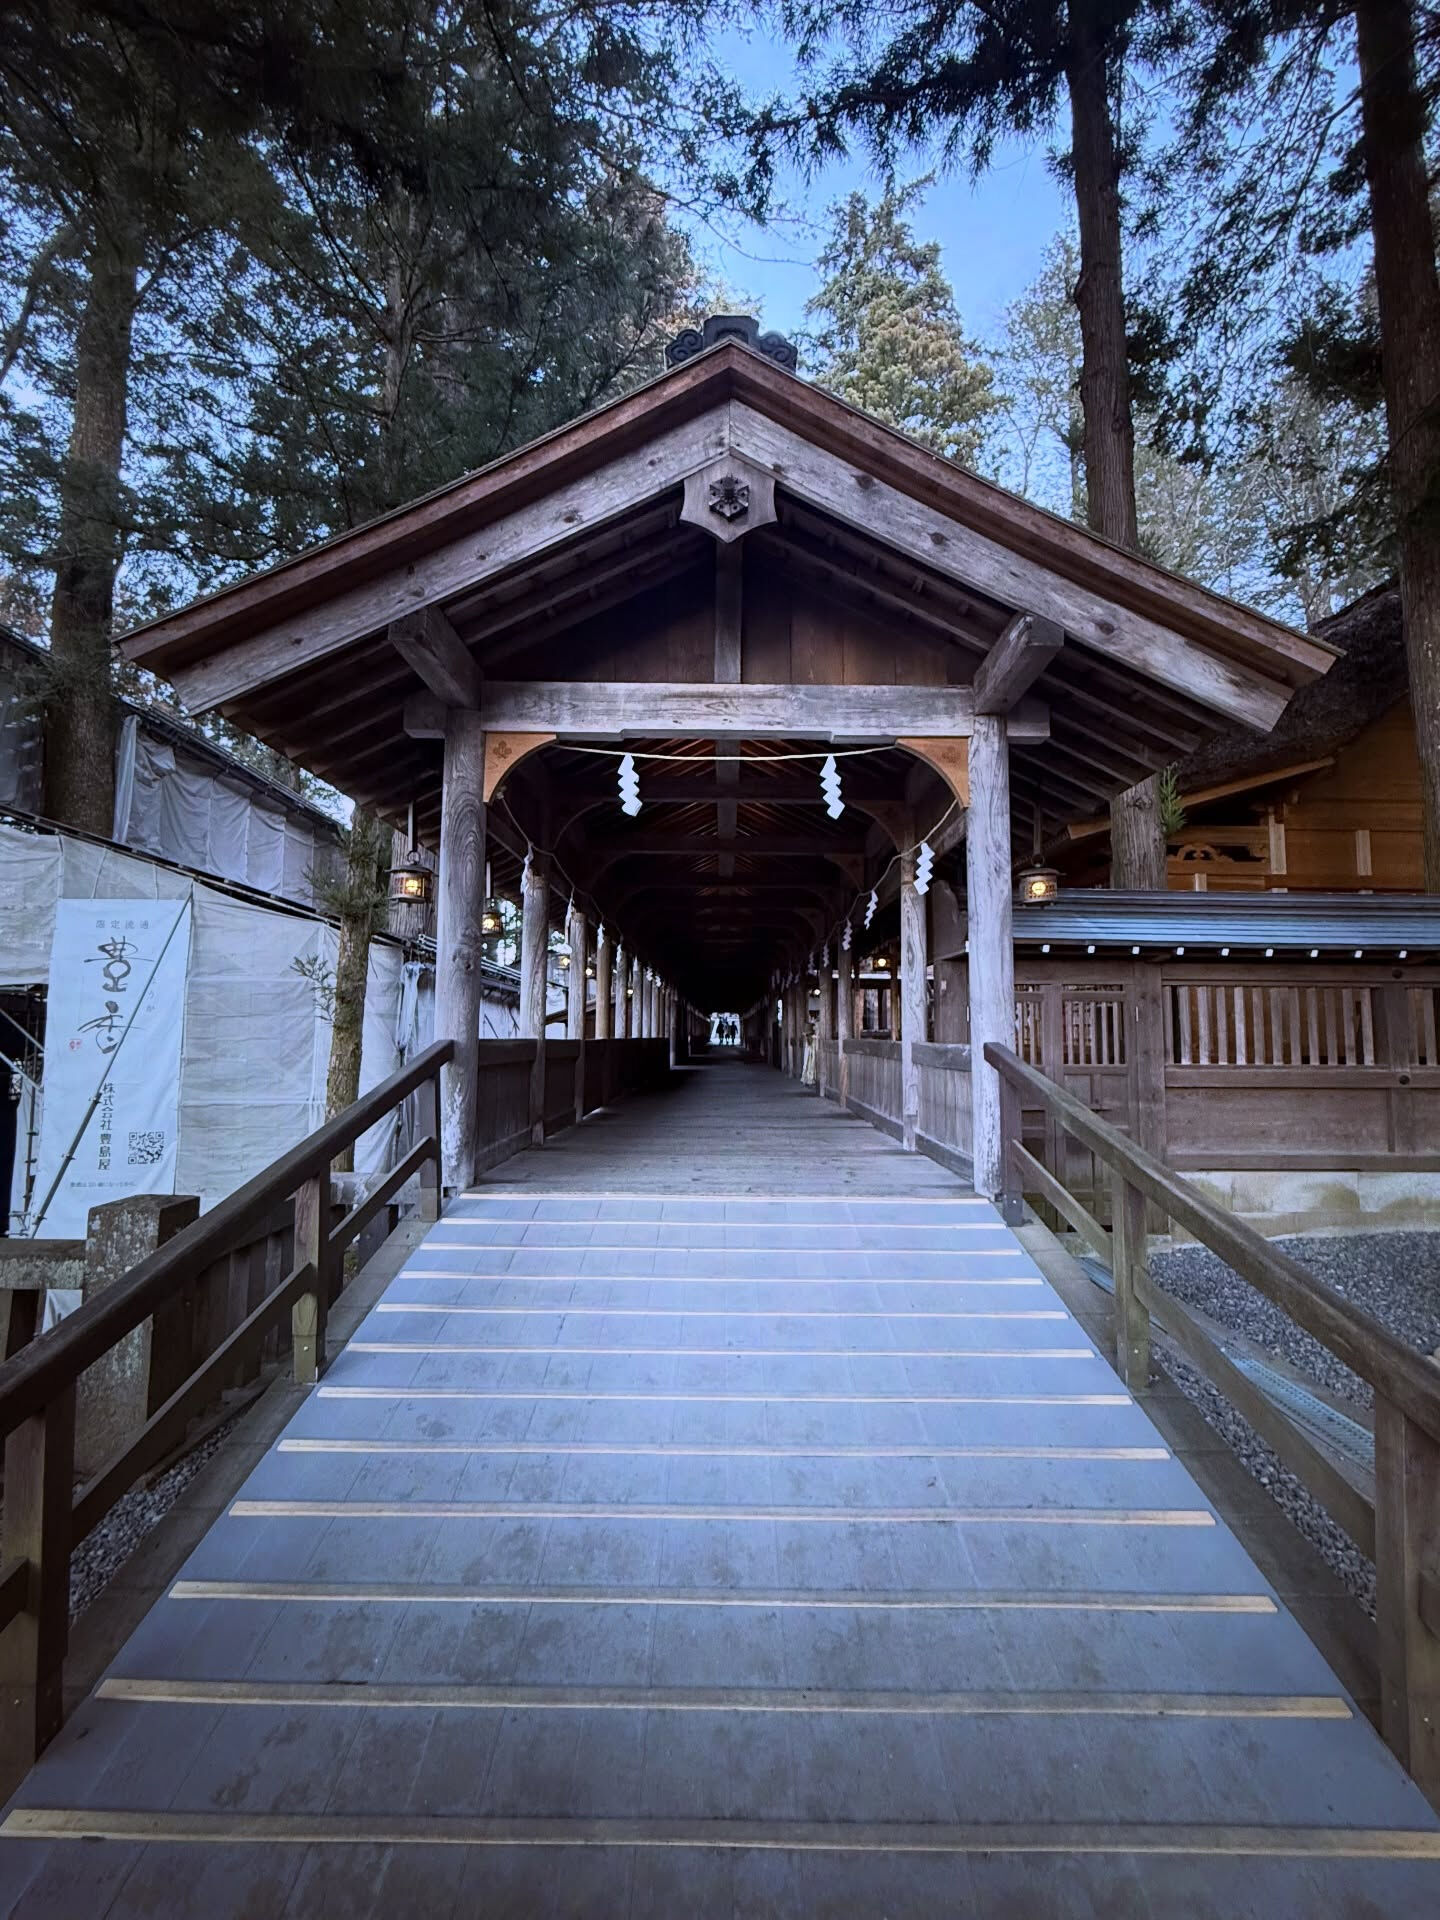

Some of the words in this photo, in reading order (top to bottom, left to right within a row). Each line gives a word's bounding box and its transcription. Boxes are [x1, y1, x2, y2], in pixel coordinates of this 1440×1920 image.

[98, 1082, 116, 1171] 株式会社豊島屋
